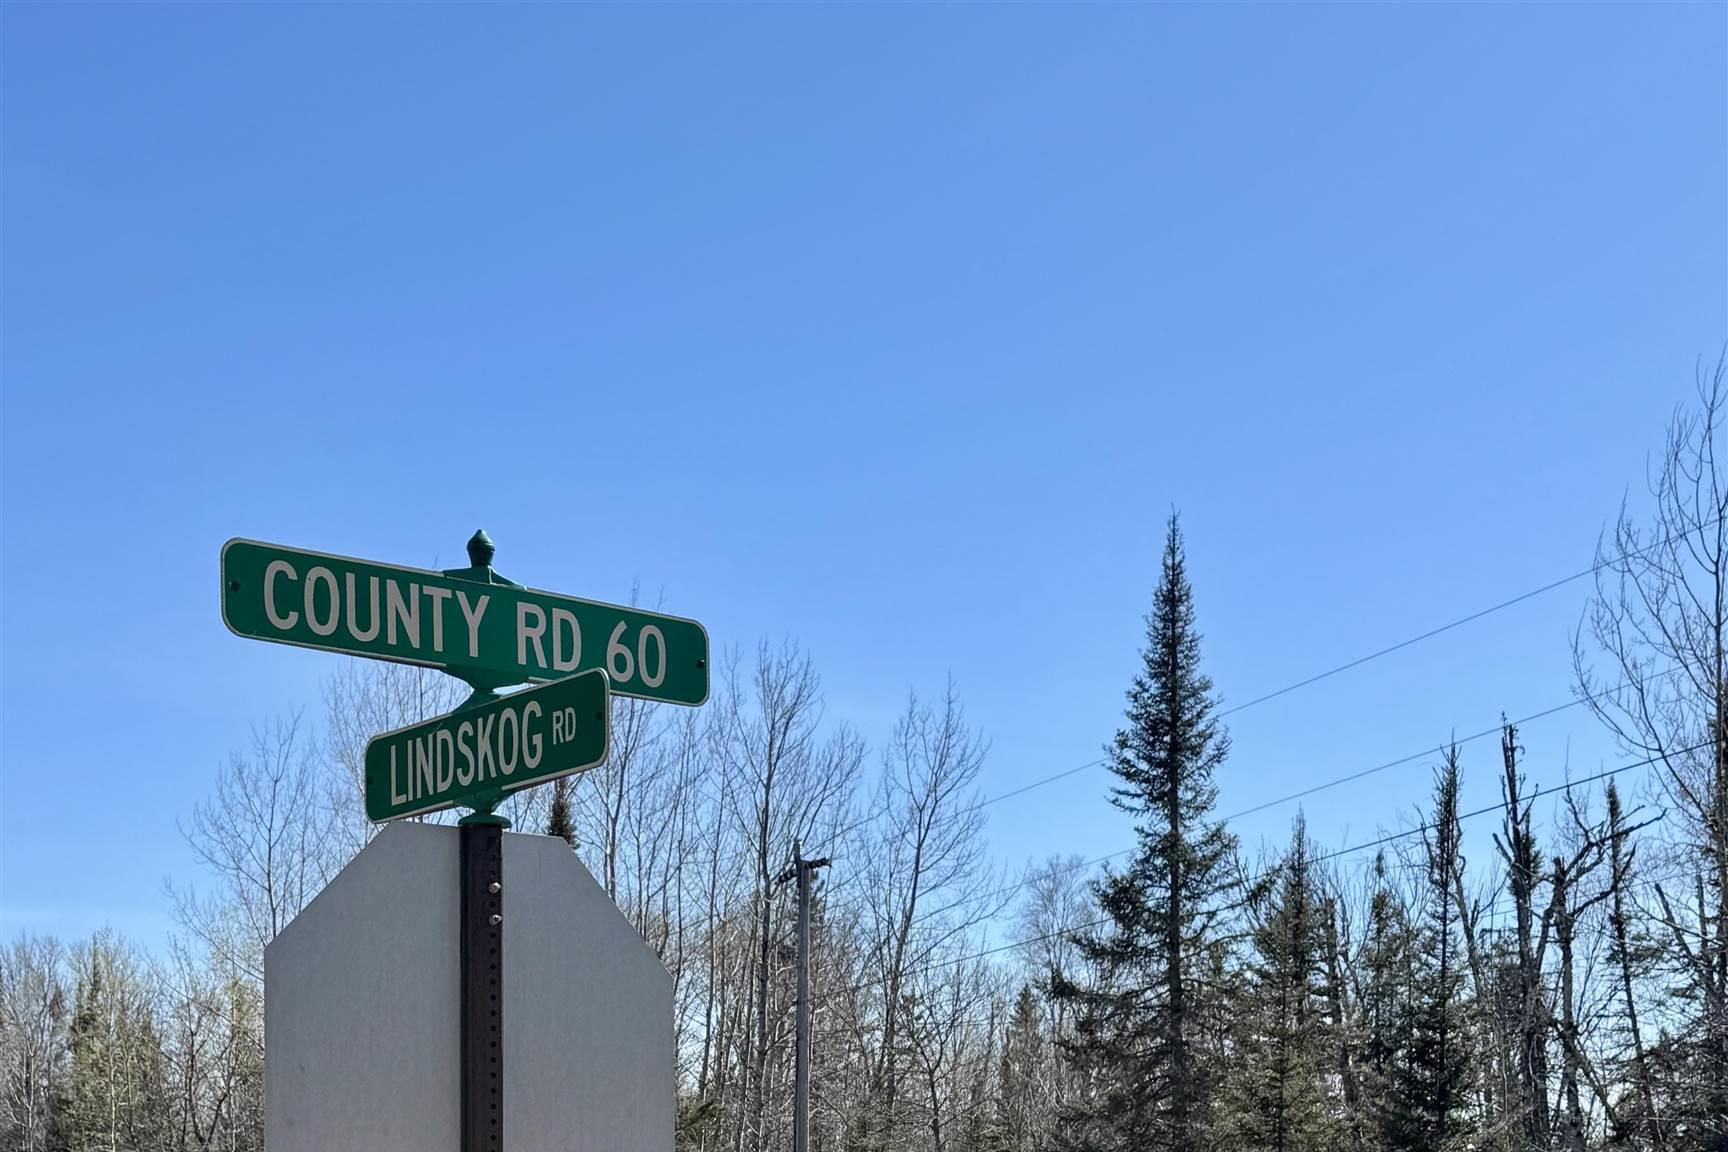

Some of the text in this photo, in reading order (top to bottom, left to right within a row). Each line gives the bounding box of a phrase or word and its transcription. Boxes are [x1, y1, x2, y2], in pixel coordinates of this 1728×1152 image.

[263, 560, 667, 688] COUNTY RD 60
[390, 700, 577, 807] LINDSKOG RD
